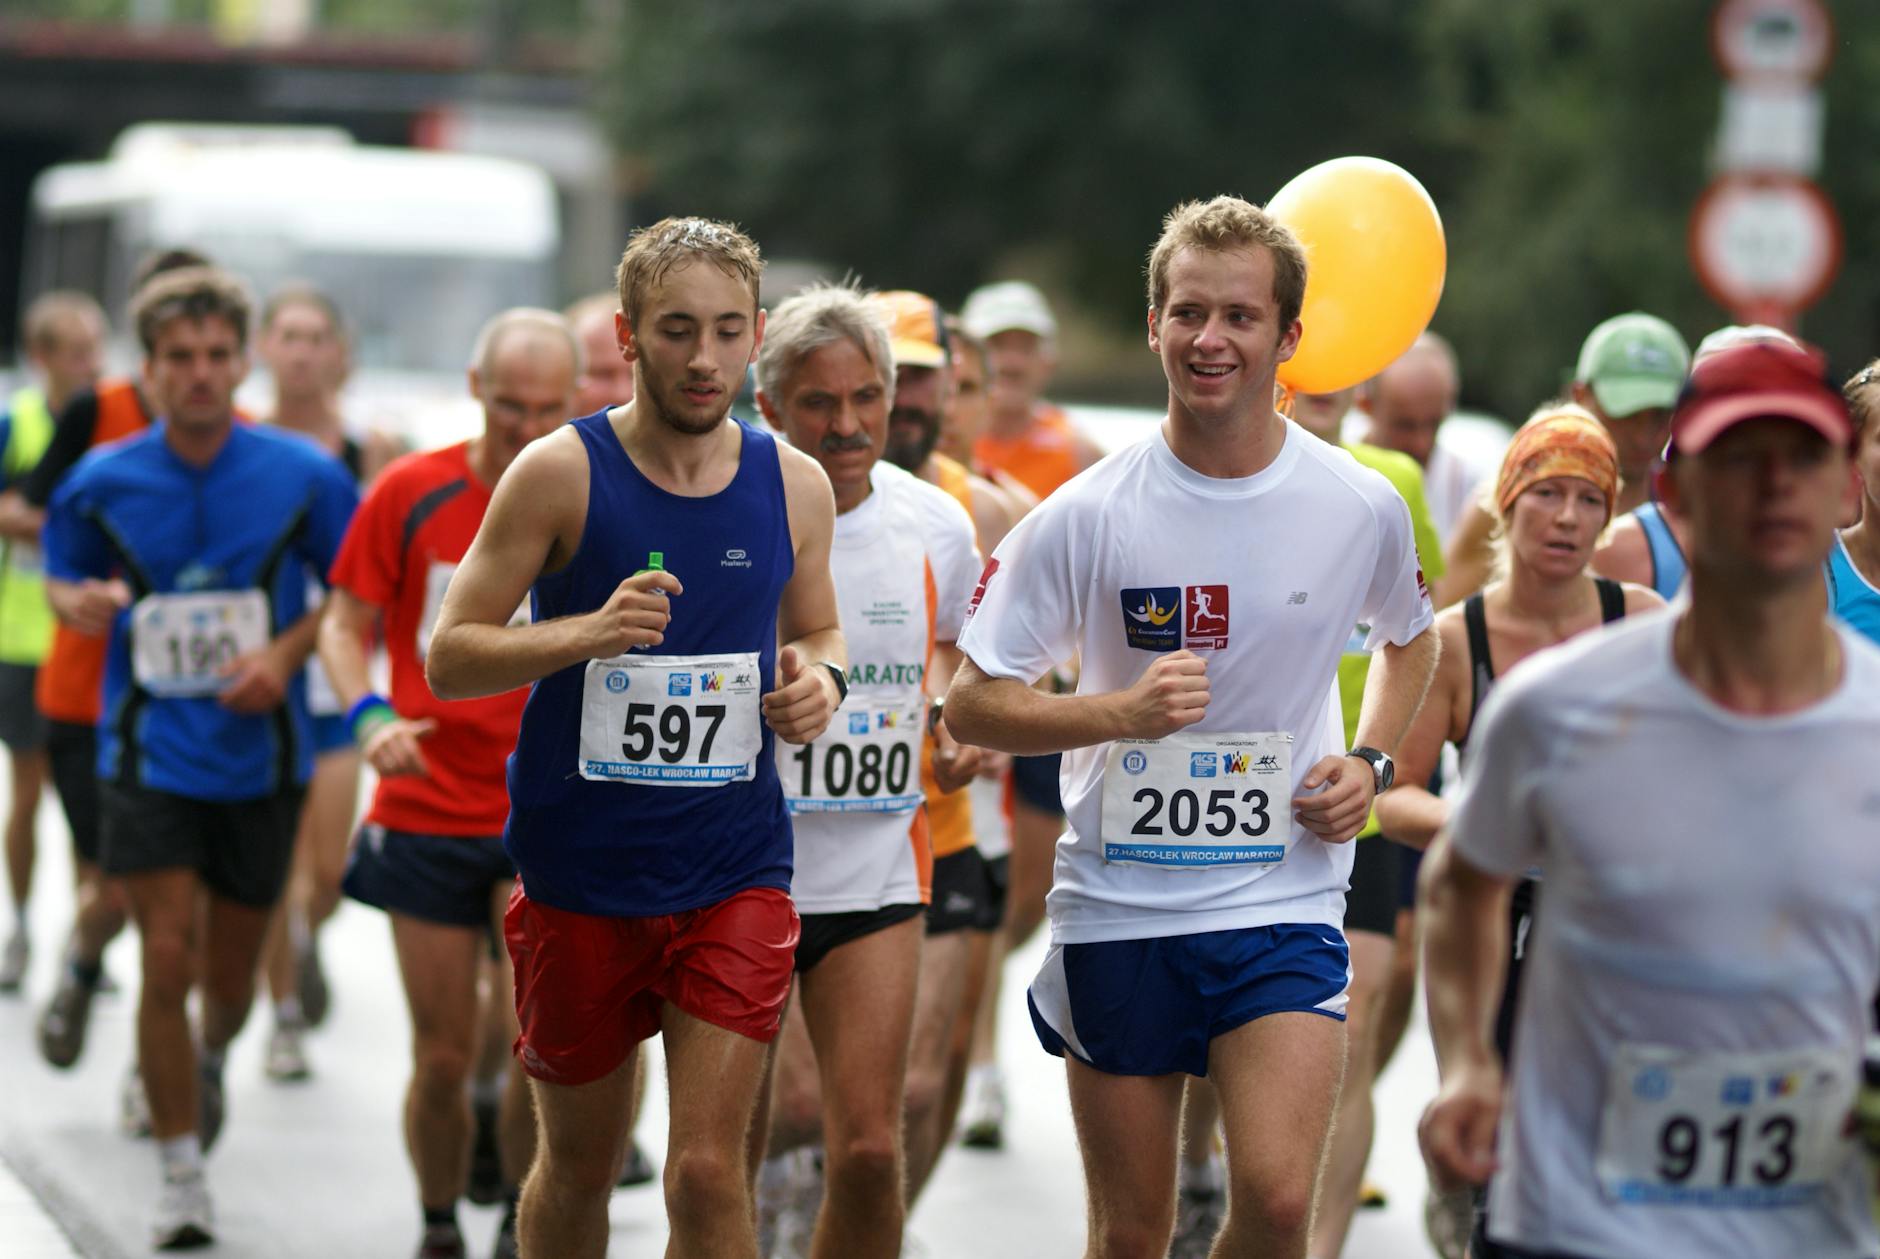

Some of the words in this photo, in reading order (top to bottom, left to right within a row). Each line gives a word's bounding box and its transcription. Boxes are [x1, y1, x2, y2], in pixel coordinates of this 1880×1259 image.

[721, 560, 752, 568] Kalenji
[848, 664, 924, 684] ARATON
[622, 703, 726, 763] 597
[608, 765, 659, 777] HASCO-LEK
[662, 767, 709, 778] WROCŁAW
[793, 742, 911, 797] 1080
[1131, 788, 1271, 837] 2053
[1182, 851, 1234, 860] WROCŁAW
[1235, 850, 1282, 860] MARATON
[1658, 1113, 1797, 1187] 913
